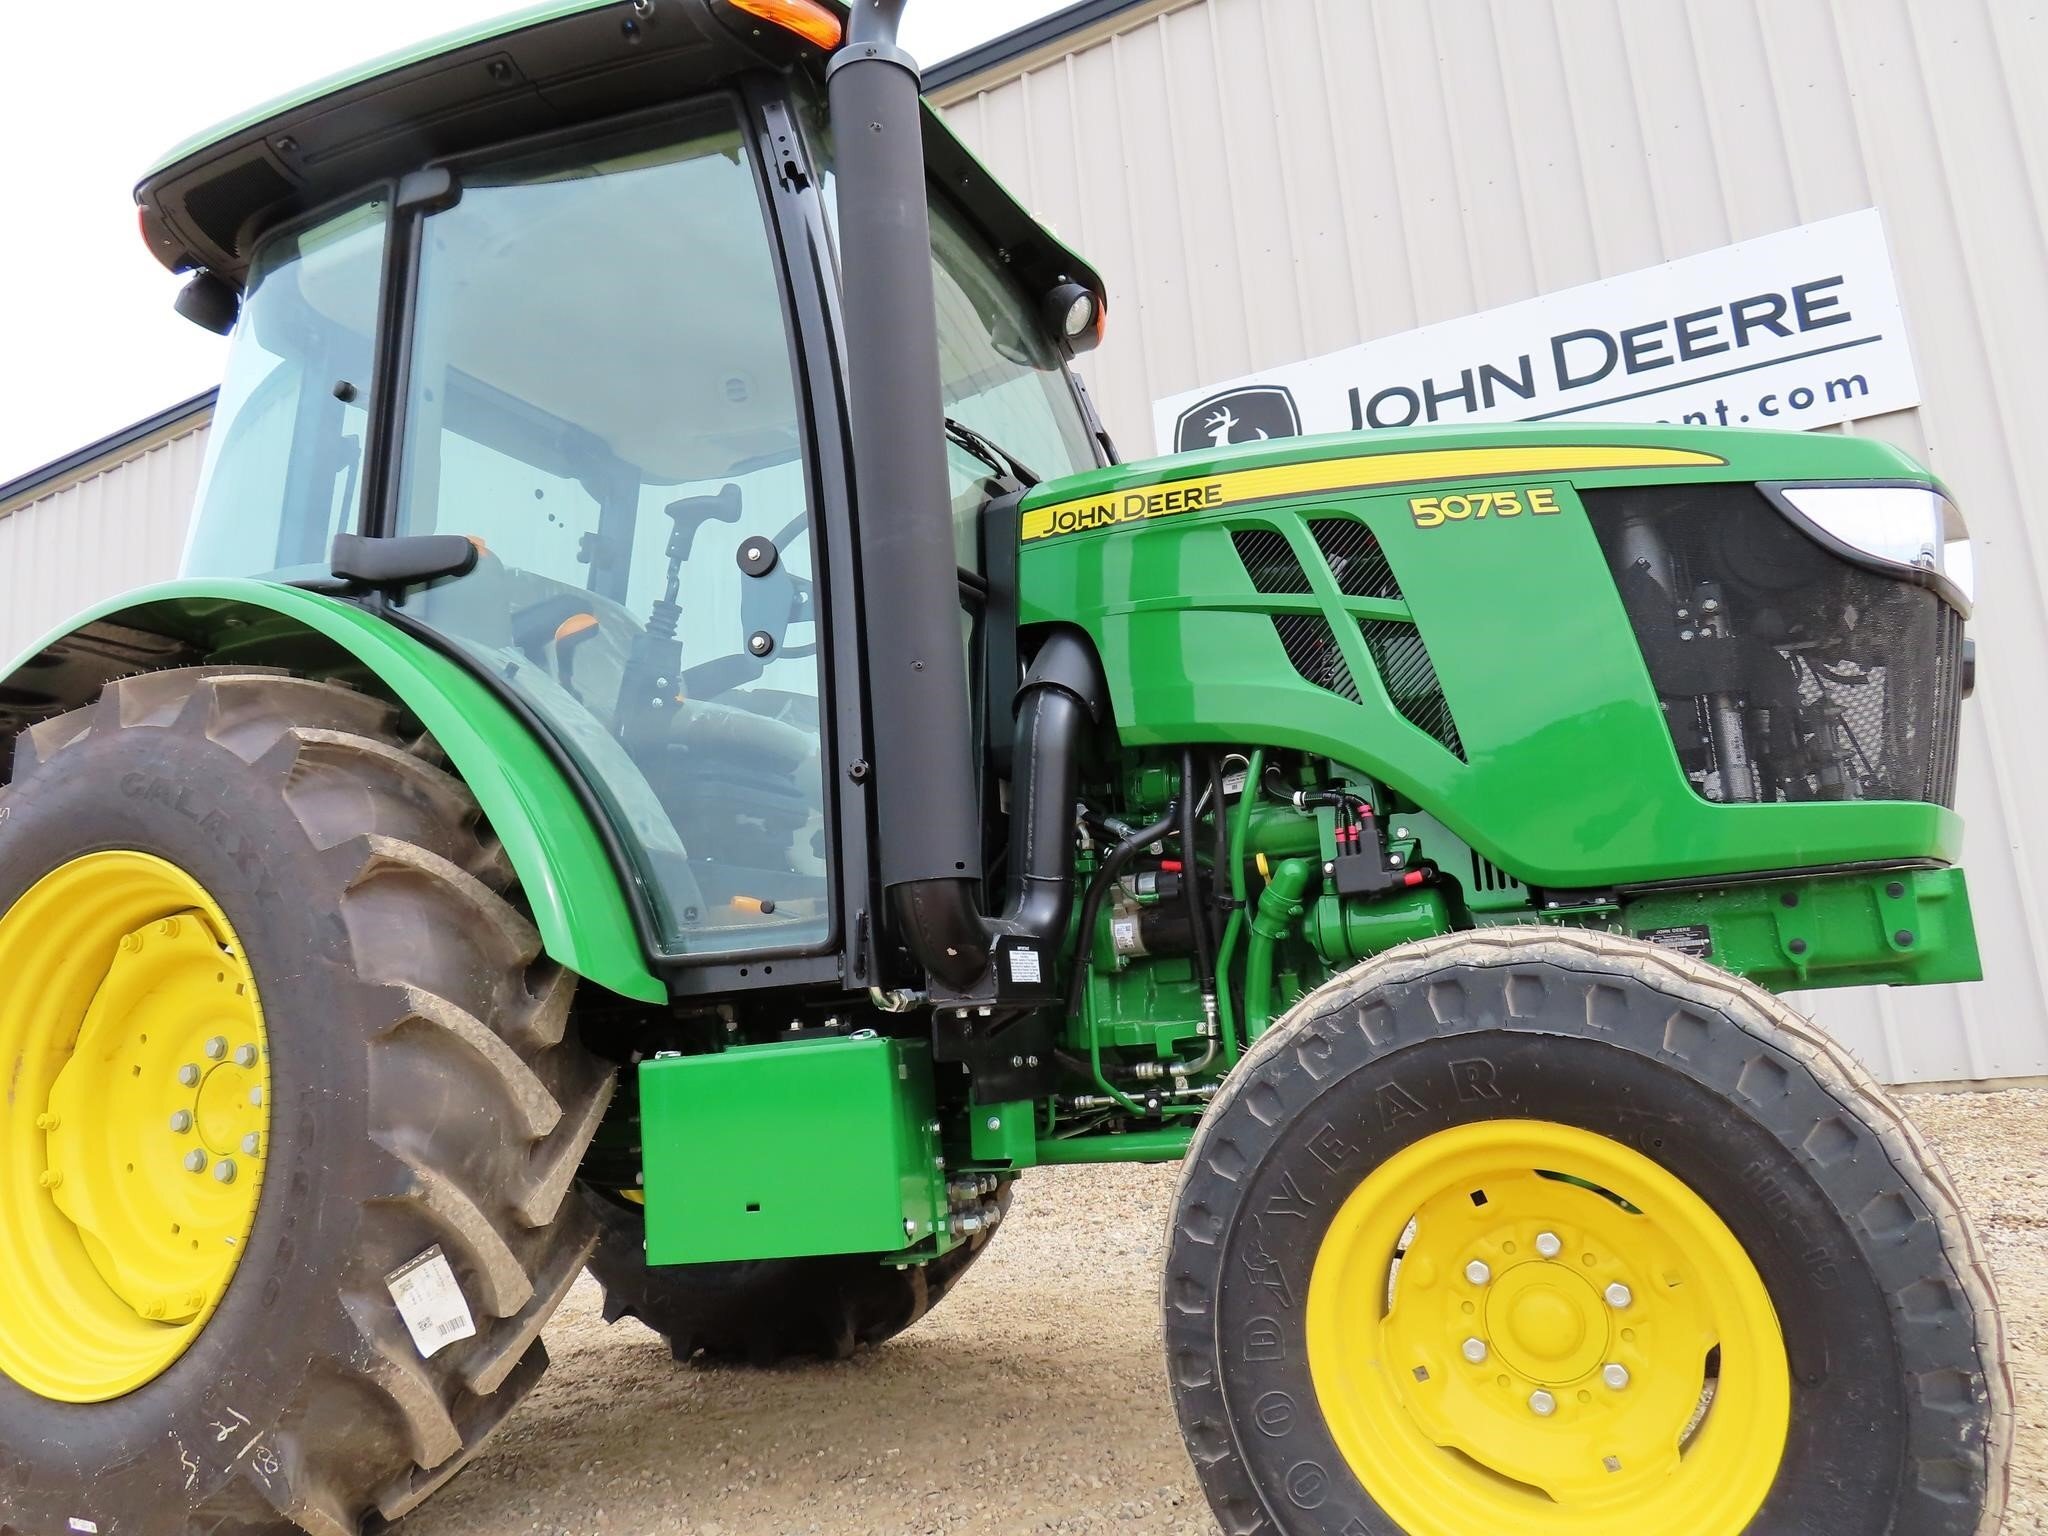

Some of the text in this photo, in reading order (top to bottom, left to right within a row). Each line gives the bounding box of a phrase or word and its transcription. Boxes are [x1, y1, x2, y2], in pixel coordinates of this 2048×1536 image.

[1347, 275, 1852, 431] JOHN DEERE
[1655, 373, 1869, 426] nt.com
[1042, 480, 1222, 534] JOHN DEERE
[1409, 488, 1562, 529] 5075 E
[390, 1248, 435, 1279] GALAXY
